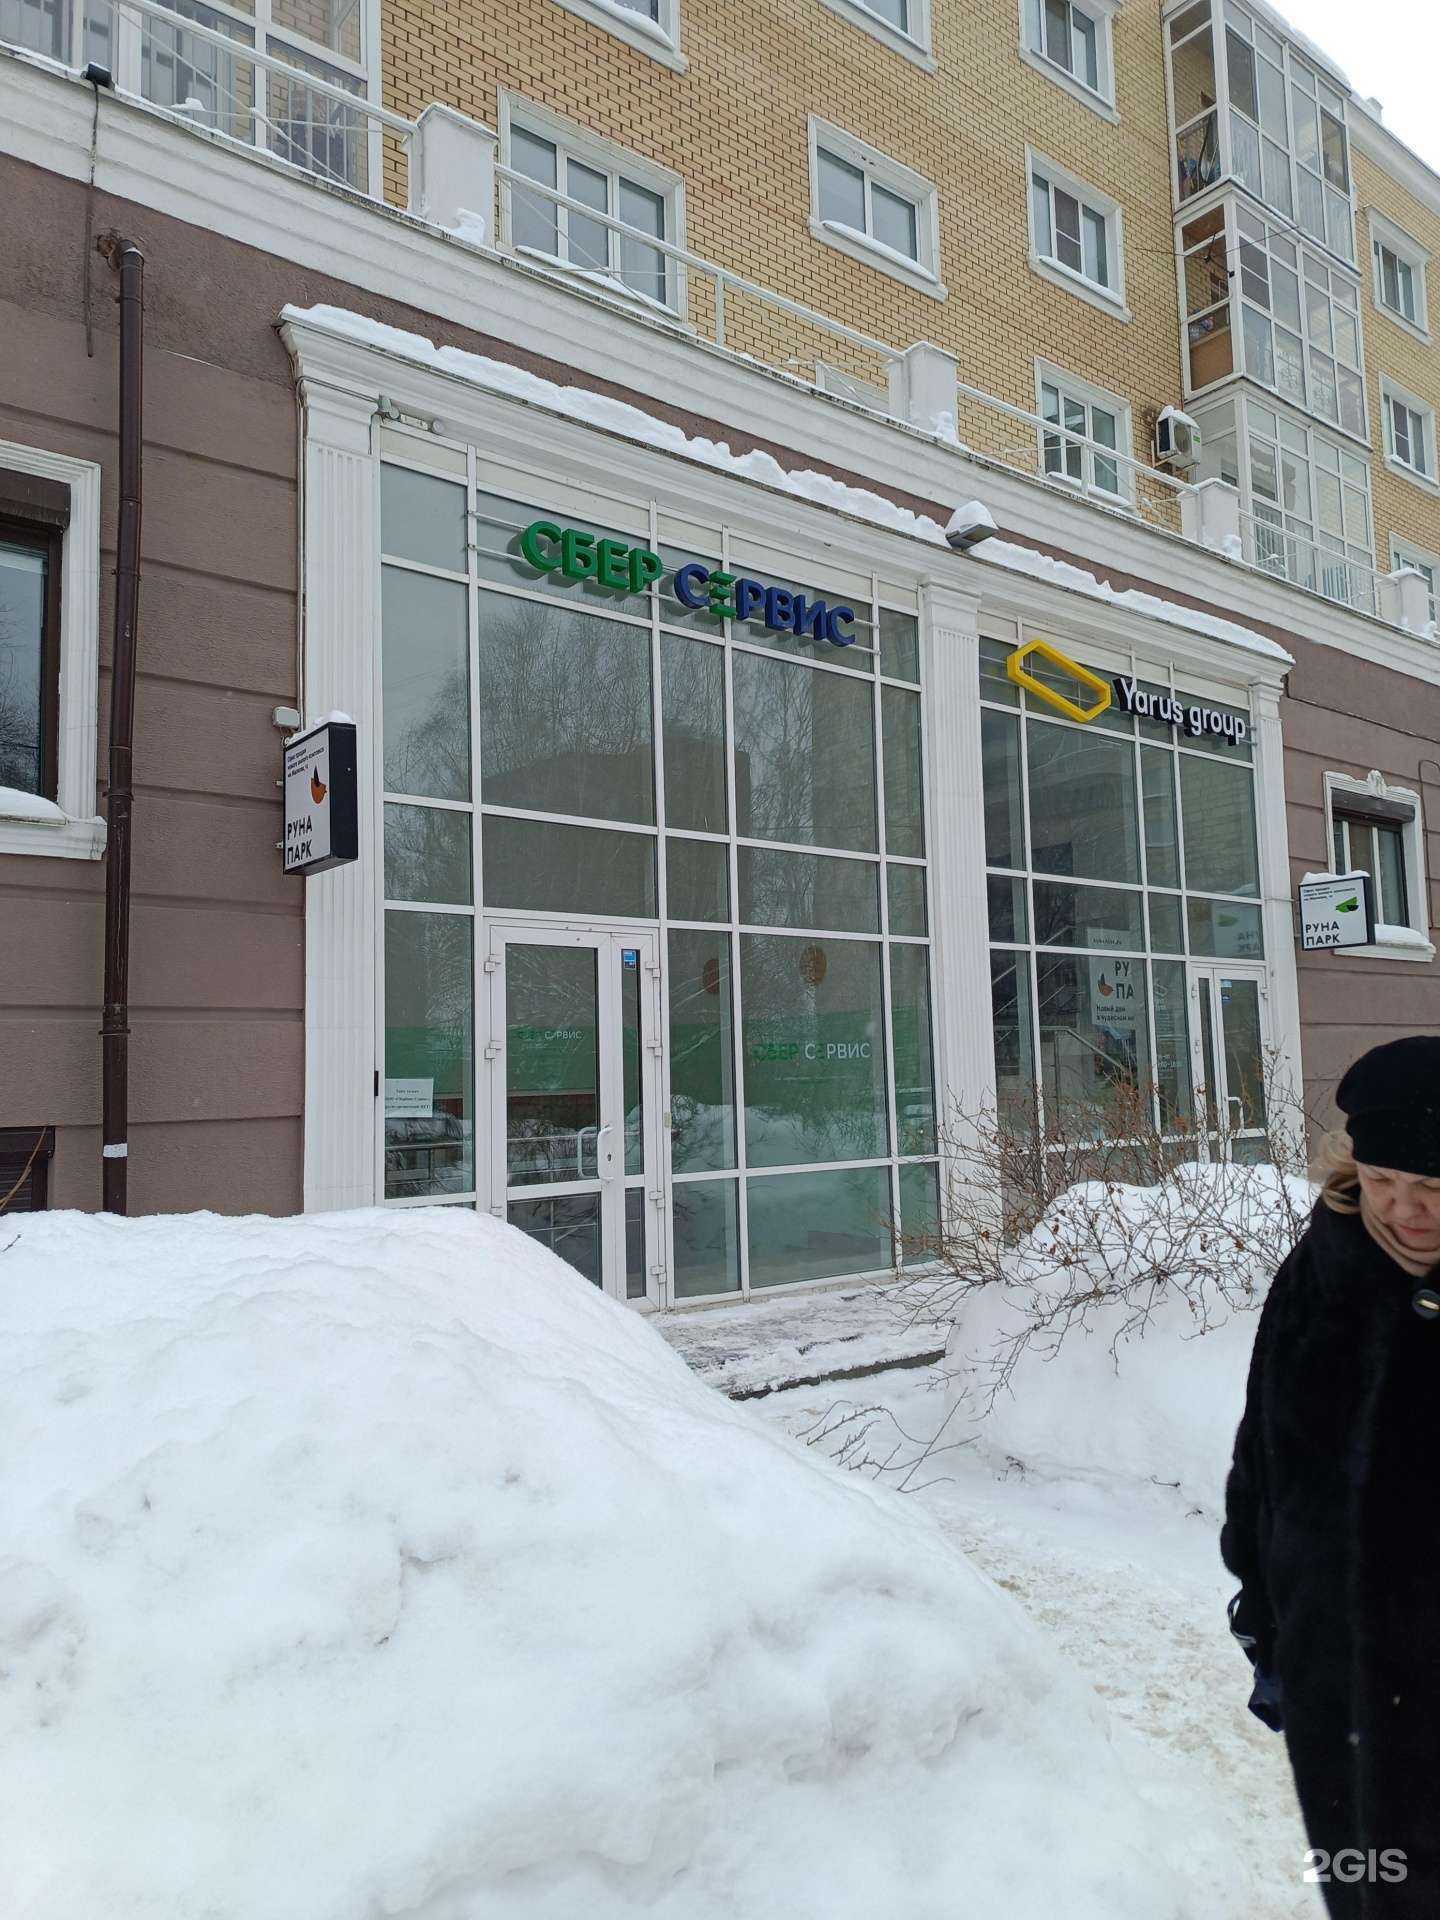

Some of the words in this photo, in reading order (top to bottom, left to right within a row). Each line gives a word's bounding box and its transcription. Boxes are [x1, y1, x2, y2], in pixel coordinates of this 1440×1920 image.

[521, 520, 662, 593] СБЕР
[674, 563, 855, 647] СЕРВИС
[1113, 678, 1183, 723] Yarus
[1188, 706, 1246, 745] group
[288, 816, 313, 841] РУНА
[287, 840, 312, 865] ПАРК
[1305, 921, 1340, 933] РУНА
[1306, 934, 1340, 946] ПАРК
[1115, 961, 1130, 977] РУ
[1116, 983, 1134, 999] ПА
